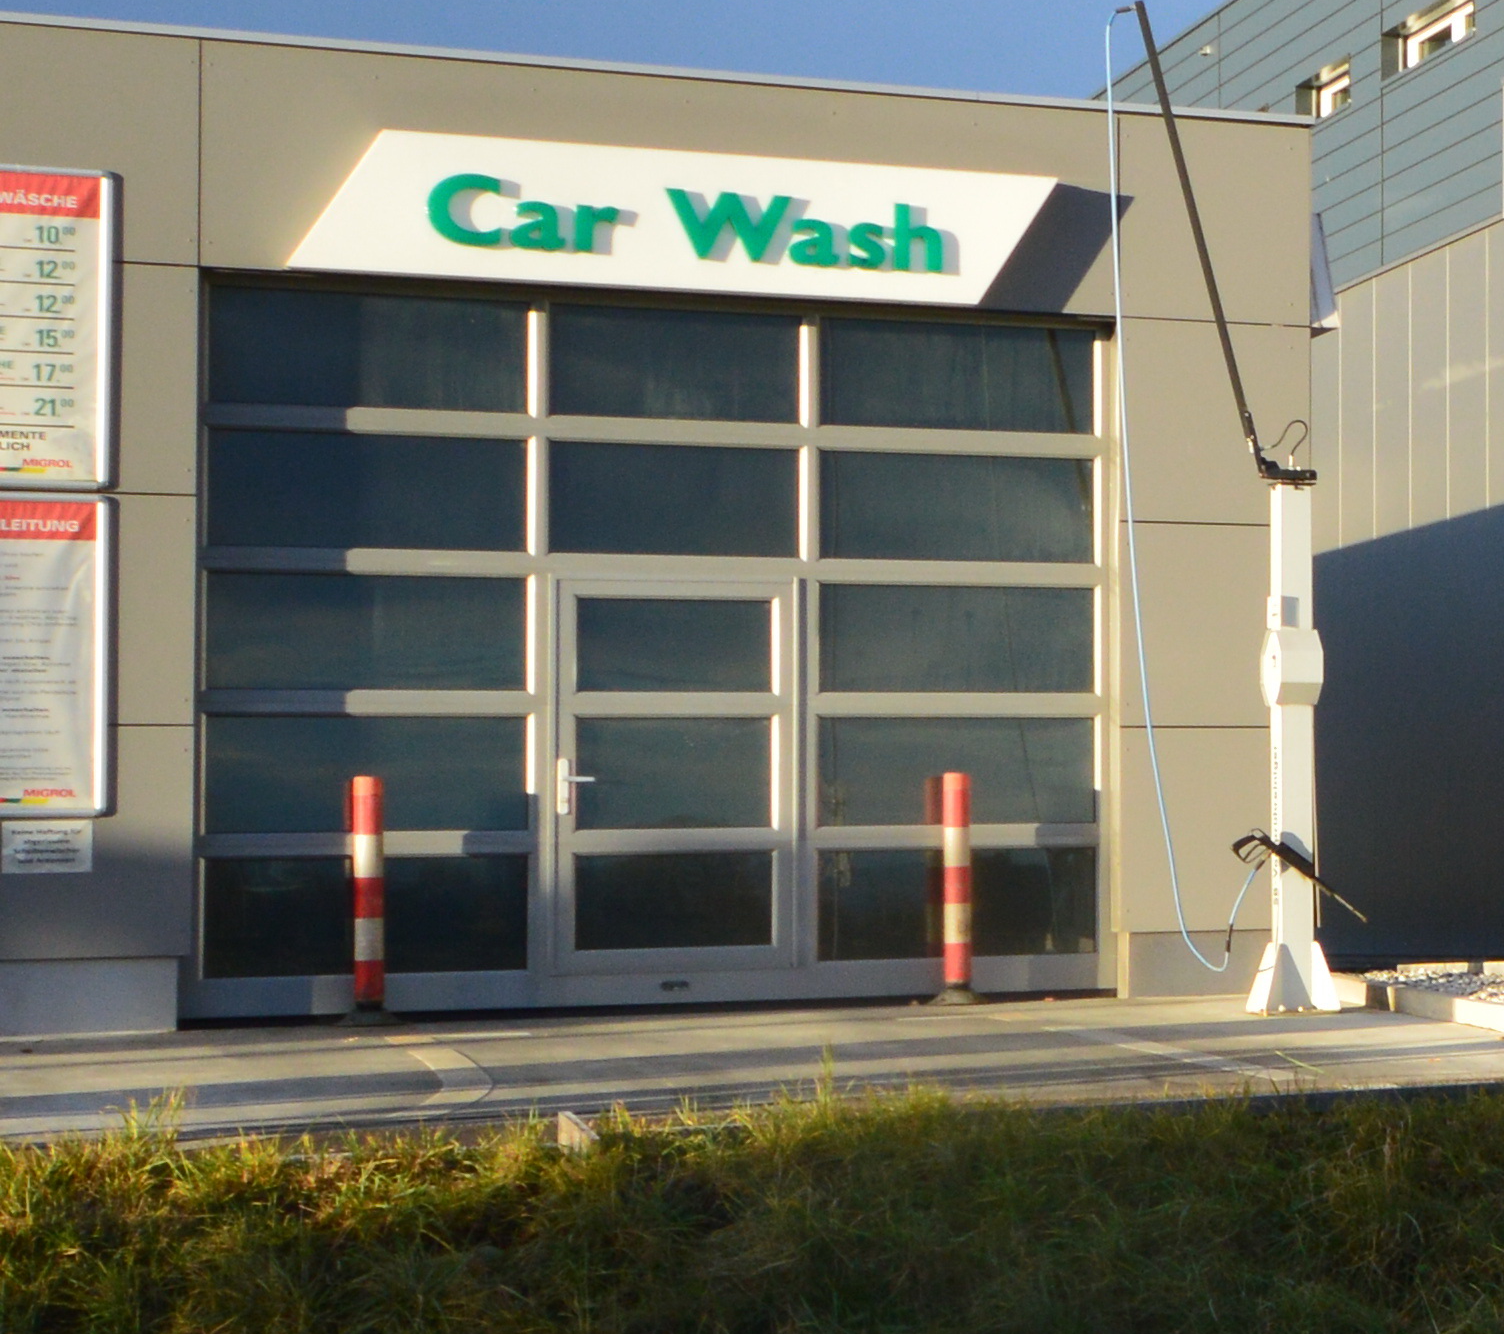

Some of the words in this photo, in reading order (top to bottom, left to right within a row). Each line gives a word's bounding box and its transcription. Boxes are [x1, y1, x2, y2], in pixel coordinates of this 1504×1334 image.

[426, 172, 620, 254] Car
[665, 187, 944, 274] Wash
[22, 458, 73, 469] MIGROL
[23, 788, 76, 798] MIGROL
